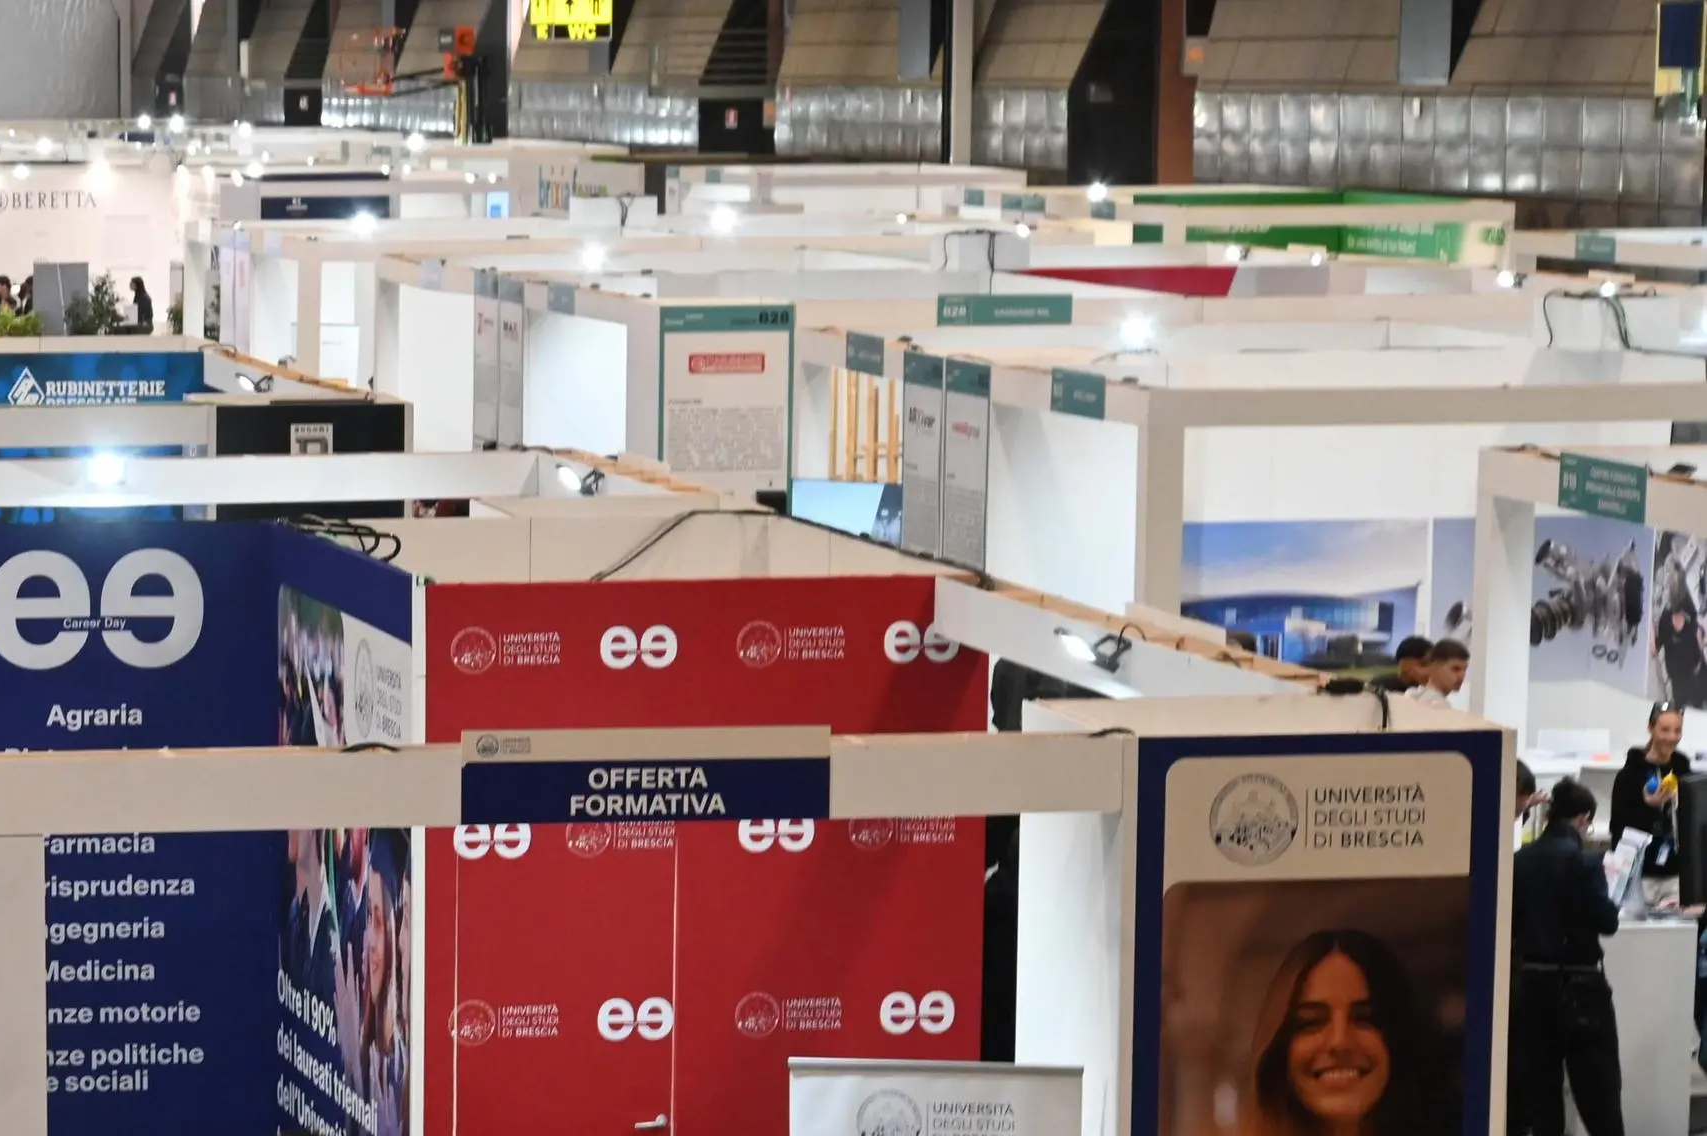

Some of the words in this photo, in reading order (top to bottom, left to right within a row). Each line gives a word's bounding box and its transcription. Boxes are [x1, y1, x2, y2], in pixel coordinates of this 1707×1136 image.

[11, 190, 97, 209] BERETTA
[45, 380, 166, 396] RUBINETTERIE
[104, 615, 127, 631] Day
[503, 656, 514, 665] DI
[517, 654, 560, 665] BRESCIA
[504, 644, 531, 654] DEGLI
[533, 643, 561, 653] STUDI
[46, 703, 143, 731] Agraria
[587, 766, 708, 790] OFFERTA
[1314, 782, 1425, 804] UNIVERSITÀ
[570, 793, 726, 817] FORMATIVA
[1314, 809, 1367, 826] DEGLI
[1373, 808, 1425, 825] STUDI
[1314, 832, 1332, 848] DI
[1341, 830, 1424, 848] BRESCIA
[45, 917, 166, 944] gegneria
[99, 1001, 201, 1023] motorie
[277, 968, 303, 1016] Oltre
[304, 987, 311, 1020] il
[311, 993, 338, 1048] 90%
[92, 1043, 204, 1070] politiche
[277, 1023, 293, 1062] dei
[294, 1033, 332, 1098] laureati
[46, 1077, 59, 1092] e
[65, 1070, 149, 1092] sociali
[932, 1118, 974, 1131] DEGLI
[976, 1119, 1016, 1131] STUDI
